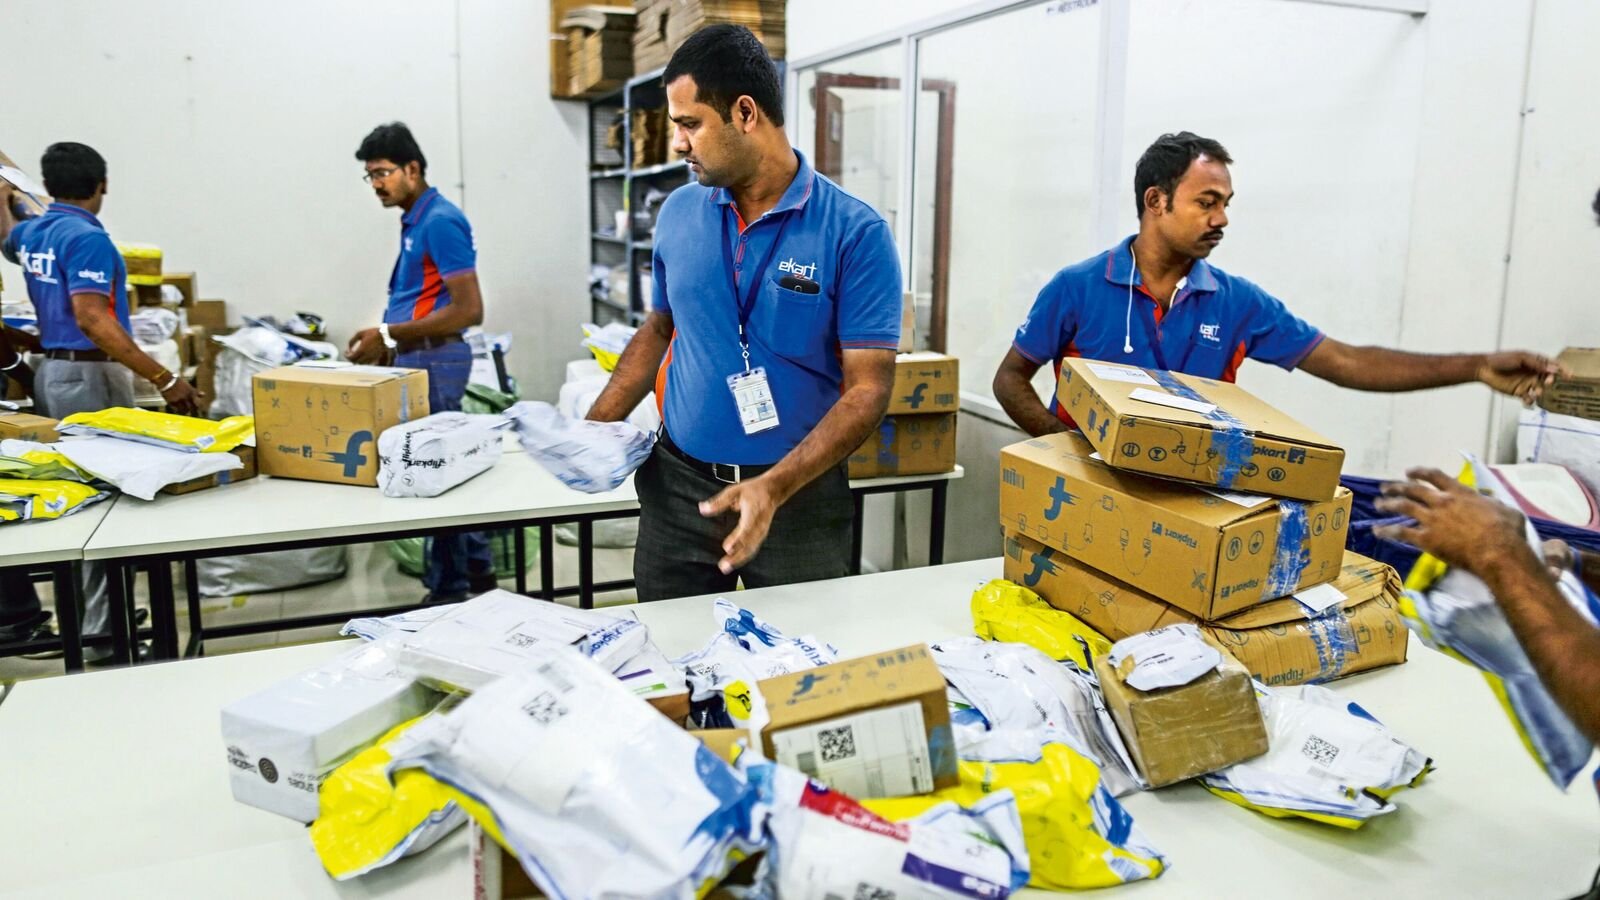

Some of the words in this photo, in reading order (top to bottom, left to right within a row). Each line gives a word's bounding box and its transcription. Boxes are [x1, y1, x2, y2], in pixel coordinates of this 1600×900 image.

[778, 258, 817, 280] ekart
[1165, 528, 1198, 549] Flipkart
[1230, 578, 1259, 596] Flipkart
